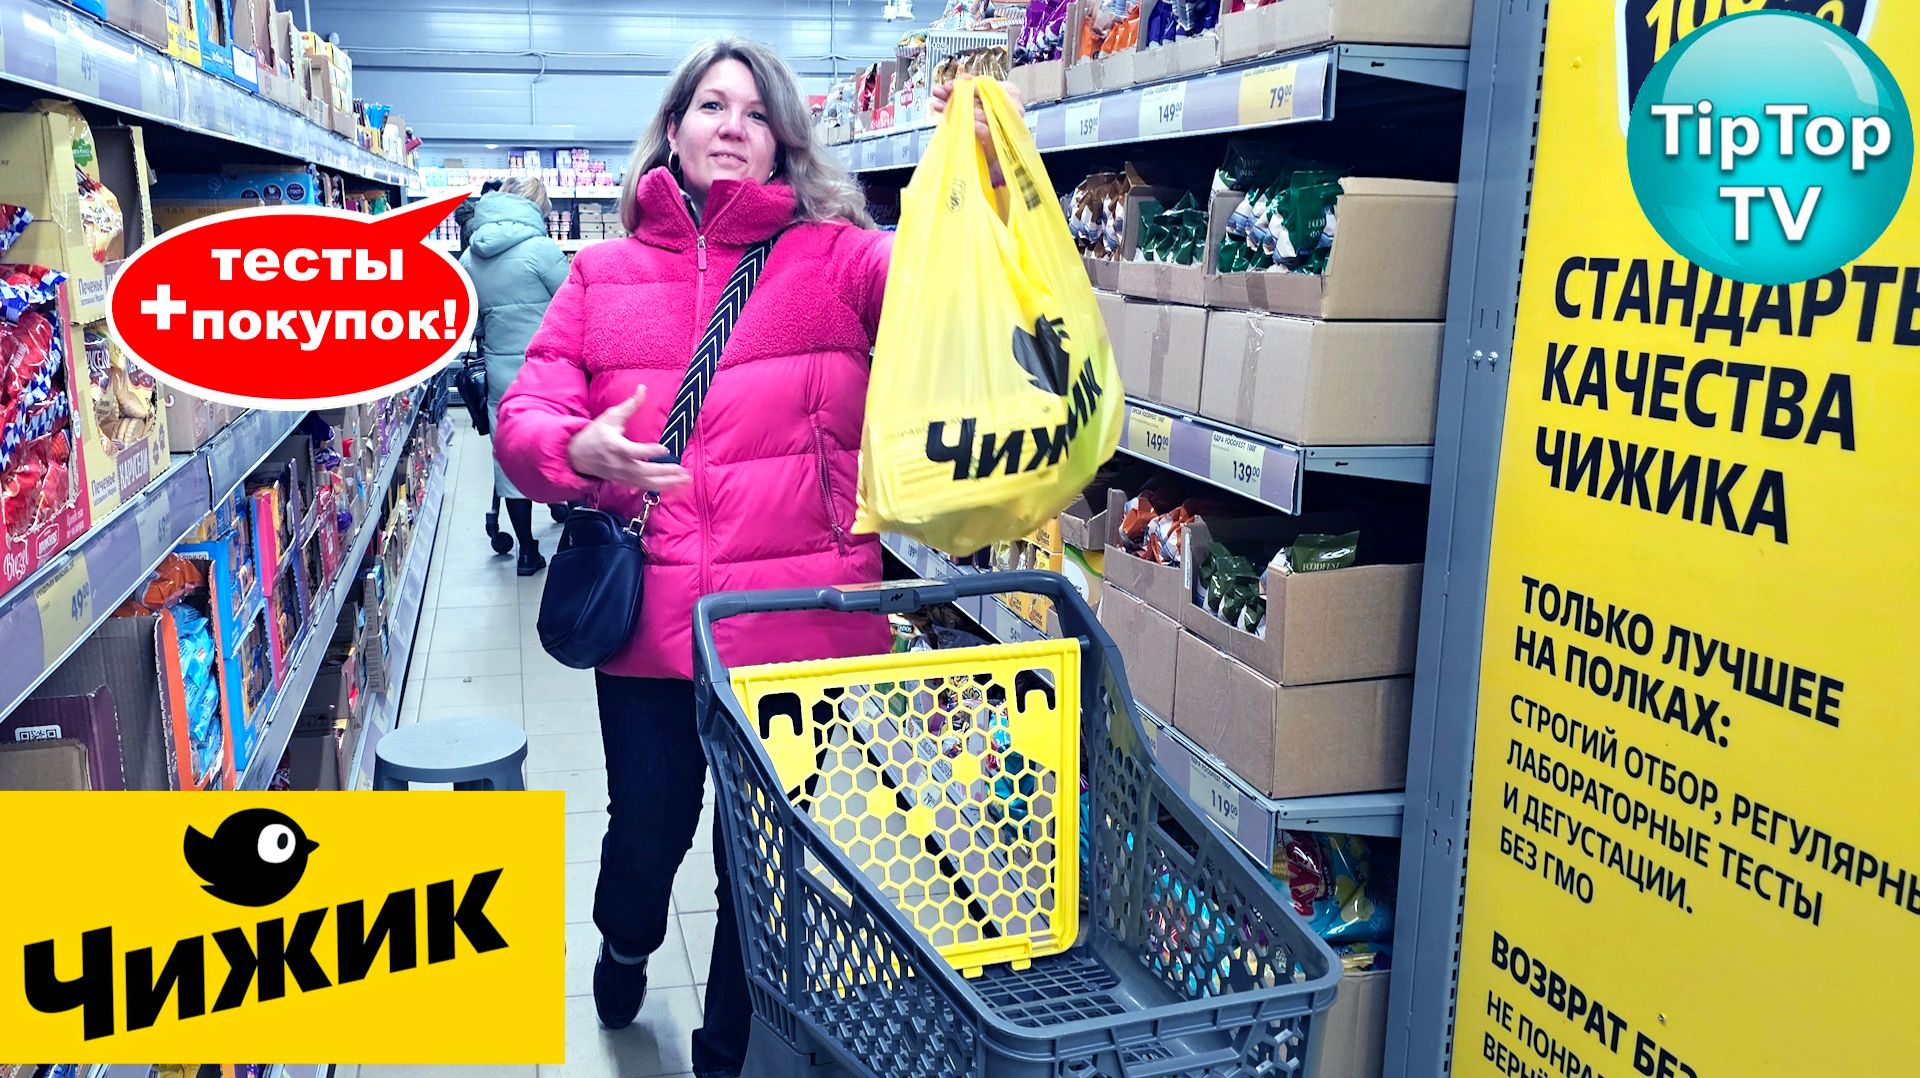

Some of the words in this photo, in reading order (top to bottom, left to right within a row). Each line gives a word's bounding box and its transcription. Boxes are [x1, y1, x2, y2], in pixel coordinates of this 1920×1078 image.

[1541, 343, 1856, 452] КАЧЕСТВА
[1535, 426, 1789, 545] ЧИЖИКА
[1514, 625, 1557, 677] НА
[1564, 644, 1731, 748] ПОЛКАХ:
[1521, 575, 1654, 656] ТОЛЬКО
[1661, 624, 1845, 728] ЛУЧШЕЕ
[1510, 694, 1618, 769] СТРОГИЙ
[1624, 746, 1722, 824] ОТБОР,
[1500, 825, 1538, 871] БЕЗ
[1543, 850, 1594, 904] ГМО
[1503, 781, 1519, 815] И
[1522, 794, 1693, 914] ДЕГУСТАЦИИ.
[1506, 738, 1711, 868] ЛАБОРАТОРНЫЕ
[1719, 842, 1823, 926] ТЕСТЫ
[1486, 990, 1514, 1033] НЕ
[1491, 930, 1628, 1054] ВОЗВРАТ
